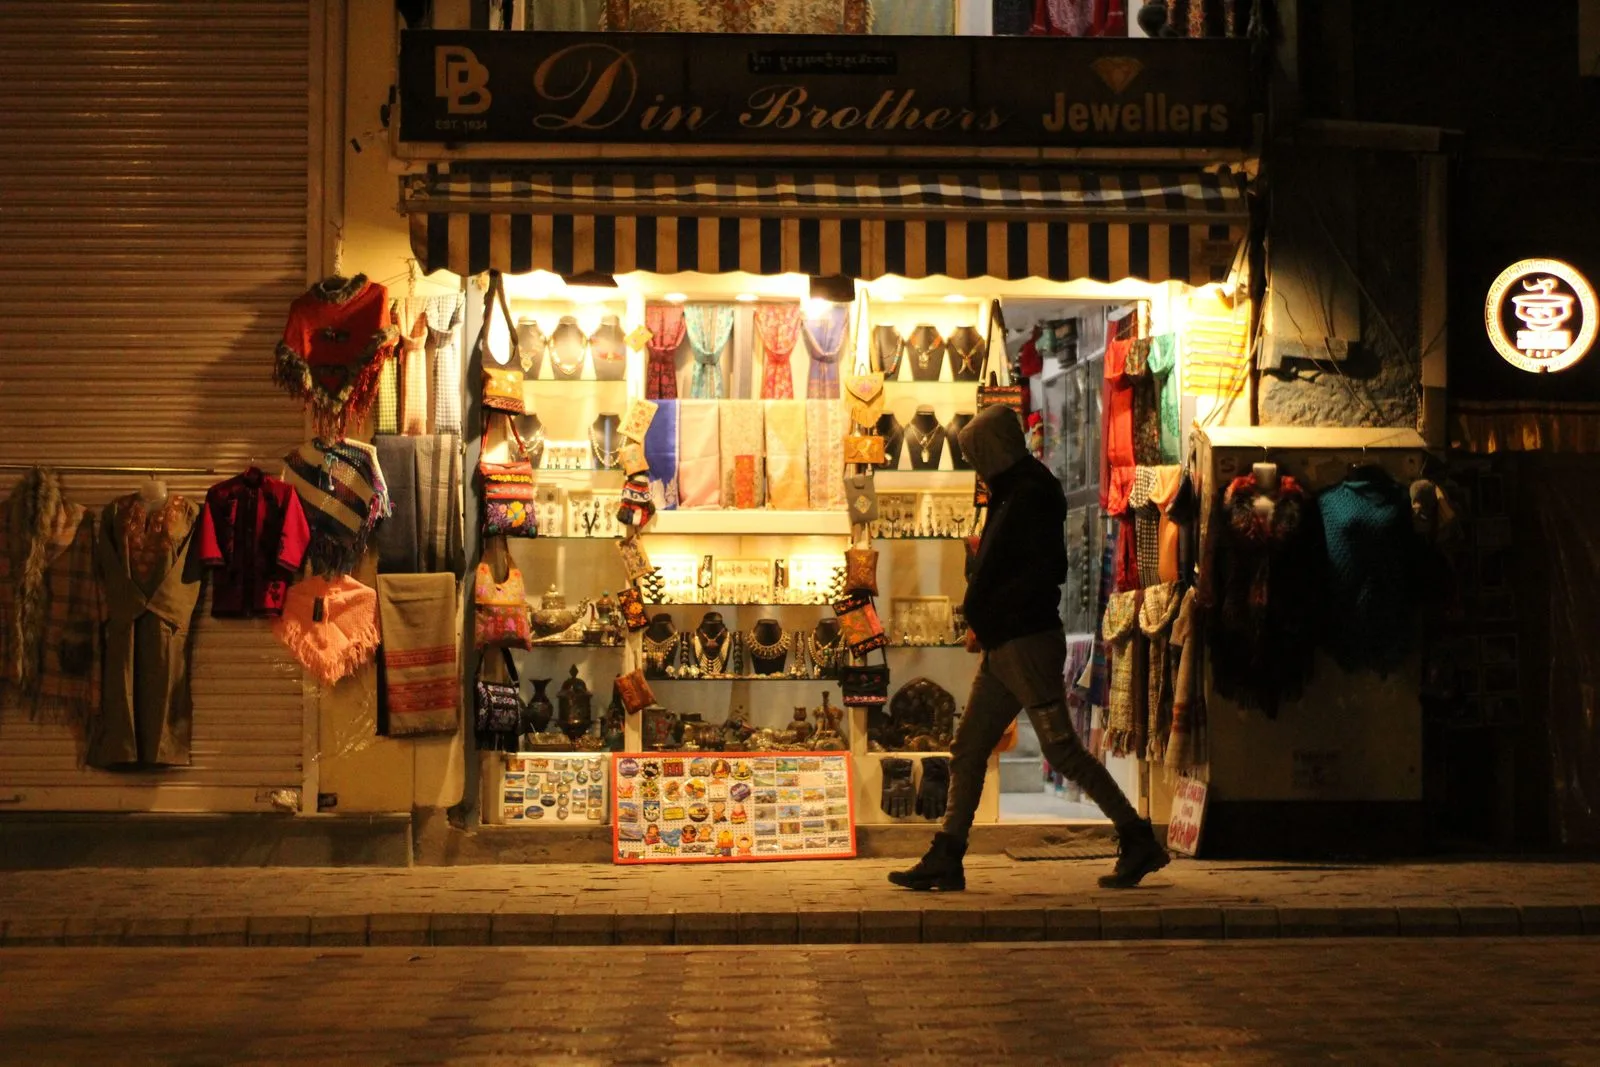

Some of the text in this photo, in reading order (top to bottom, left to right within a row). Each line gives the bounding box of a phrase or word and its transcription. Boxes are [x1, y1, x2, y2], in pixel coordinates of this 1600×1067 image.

[532, 42, 1012, 131] Din Brothers
[1042, 92, 1229, 133] Jewellers
